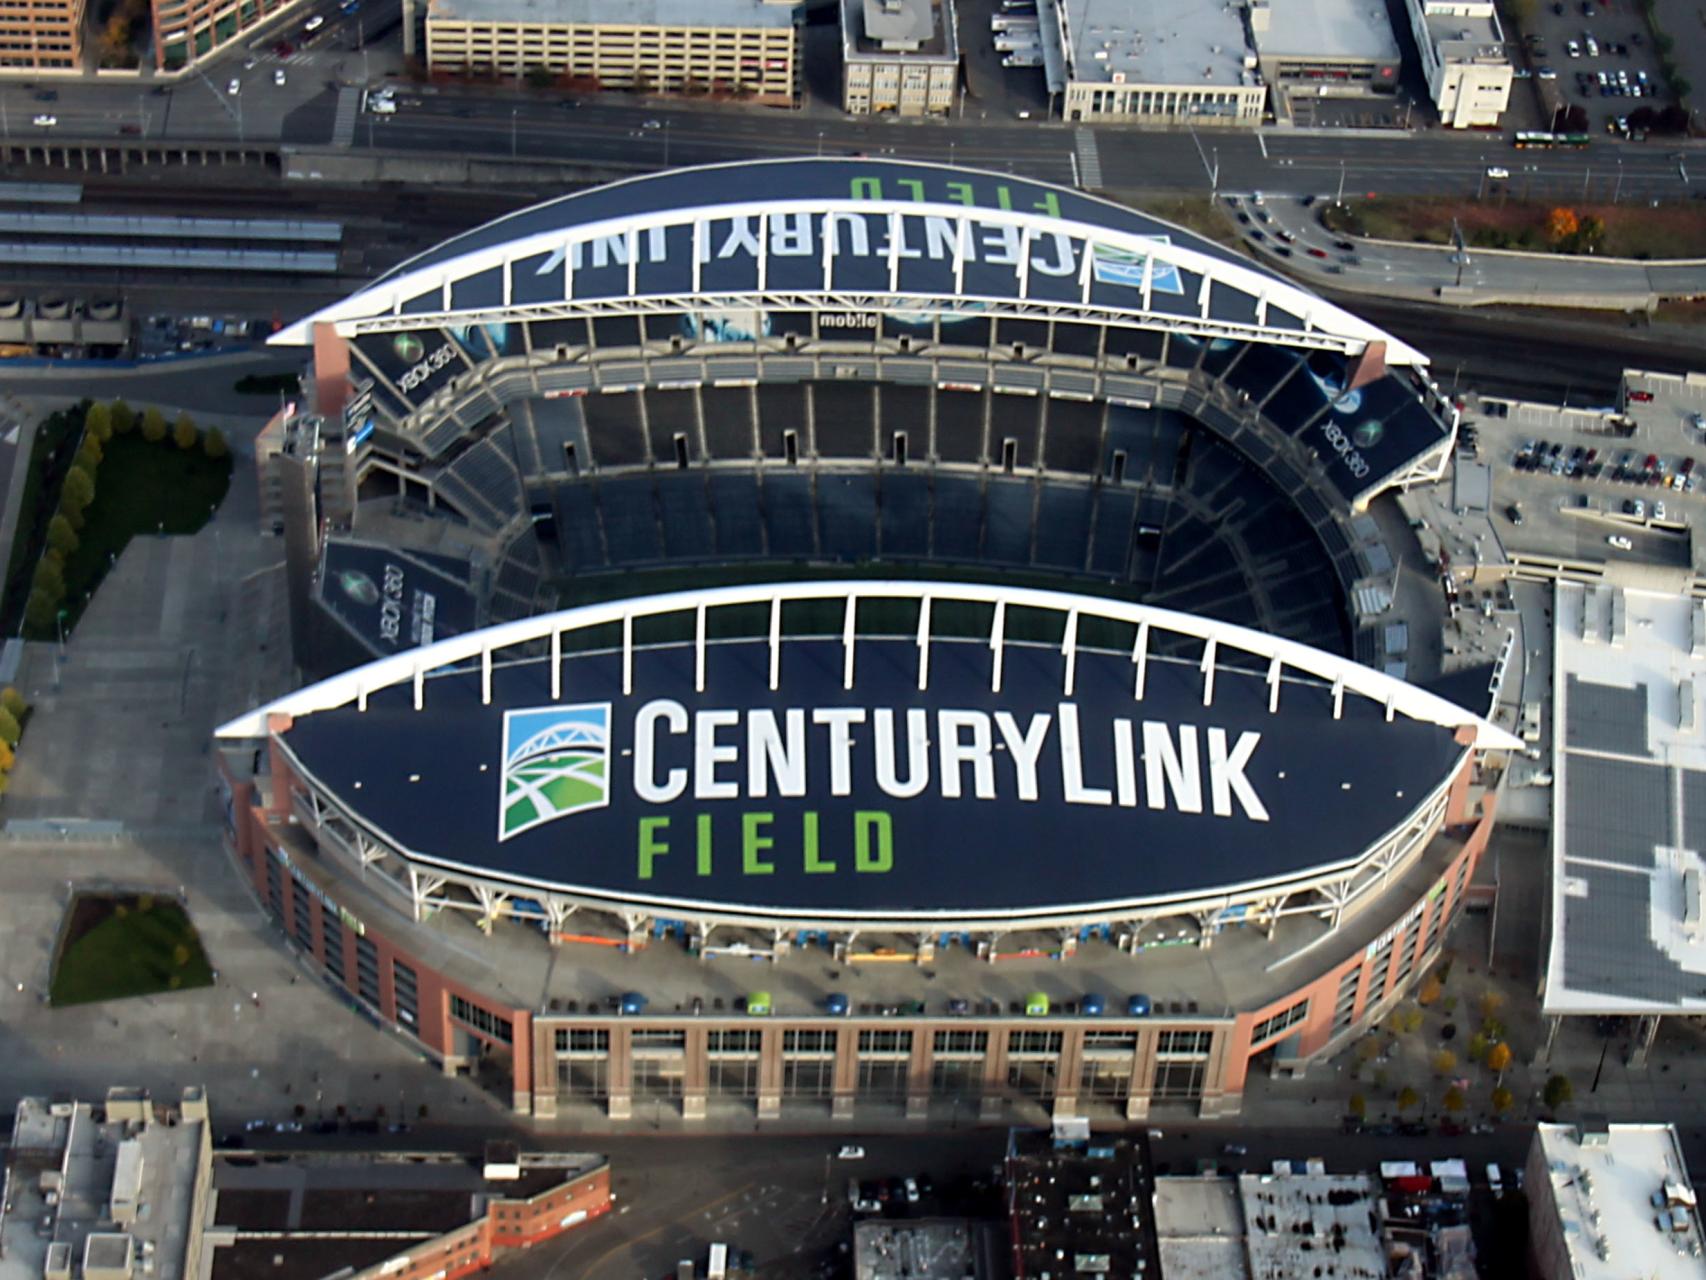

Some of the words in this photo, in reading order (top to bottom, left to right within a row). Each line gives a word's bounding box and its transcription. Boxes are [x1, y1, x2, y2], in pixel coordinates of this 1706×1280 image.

[850, 176, 1062, 219] FIELD
[396, 359, 435, 394] XBOX
[429, 343, 457, 370] 360
[1320, 419, 1353, 457] XBOX
[1345, 451, 1370, 479] 360
[380, 597, 402, 645] XBOX
[633, 698, 1270, 821] CENTURYLINK
[637, 811, 894, 879] FIELD
